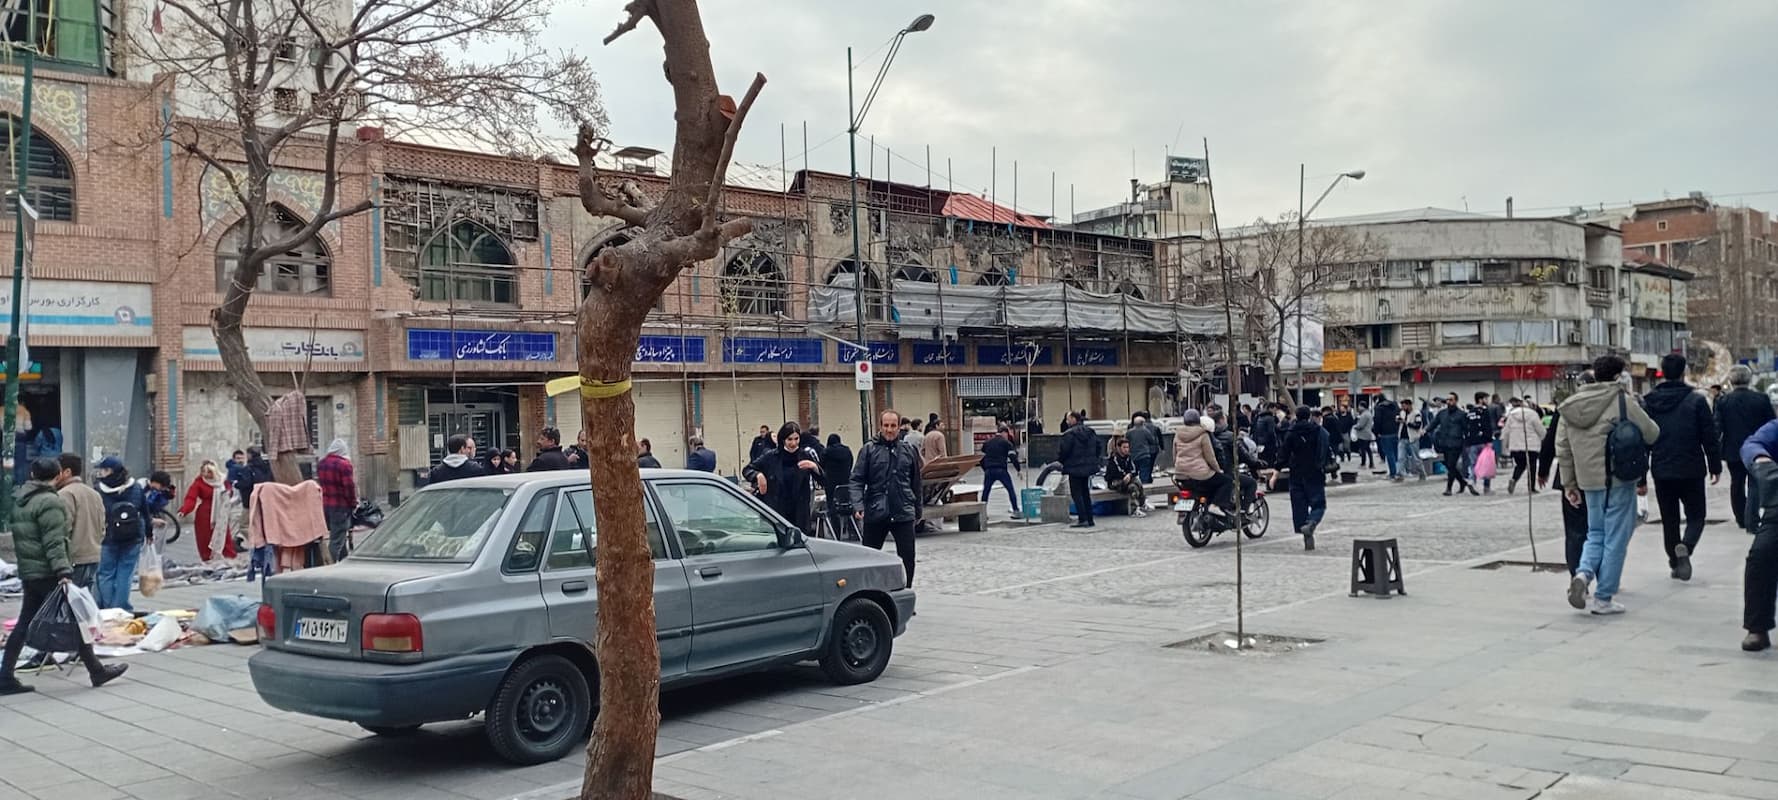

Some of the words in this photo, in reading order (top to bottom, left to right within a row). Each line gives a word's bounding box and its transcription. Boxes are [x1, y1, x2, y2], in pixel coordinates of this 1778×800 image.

[57, 296, 100, 308] کارگزاری
[456, 332, 497, 359] کشاورزی
[485, 334, 511, 359] بانک
[768, 345, 793, 359] فروشگاه
[871, 347, 895, 361] فروشگاه
